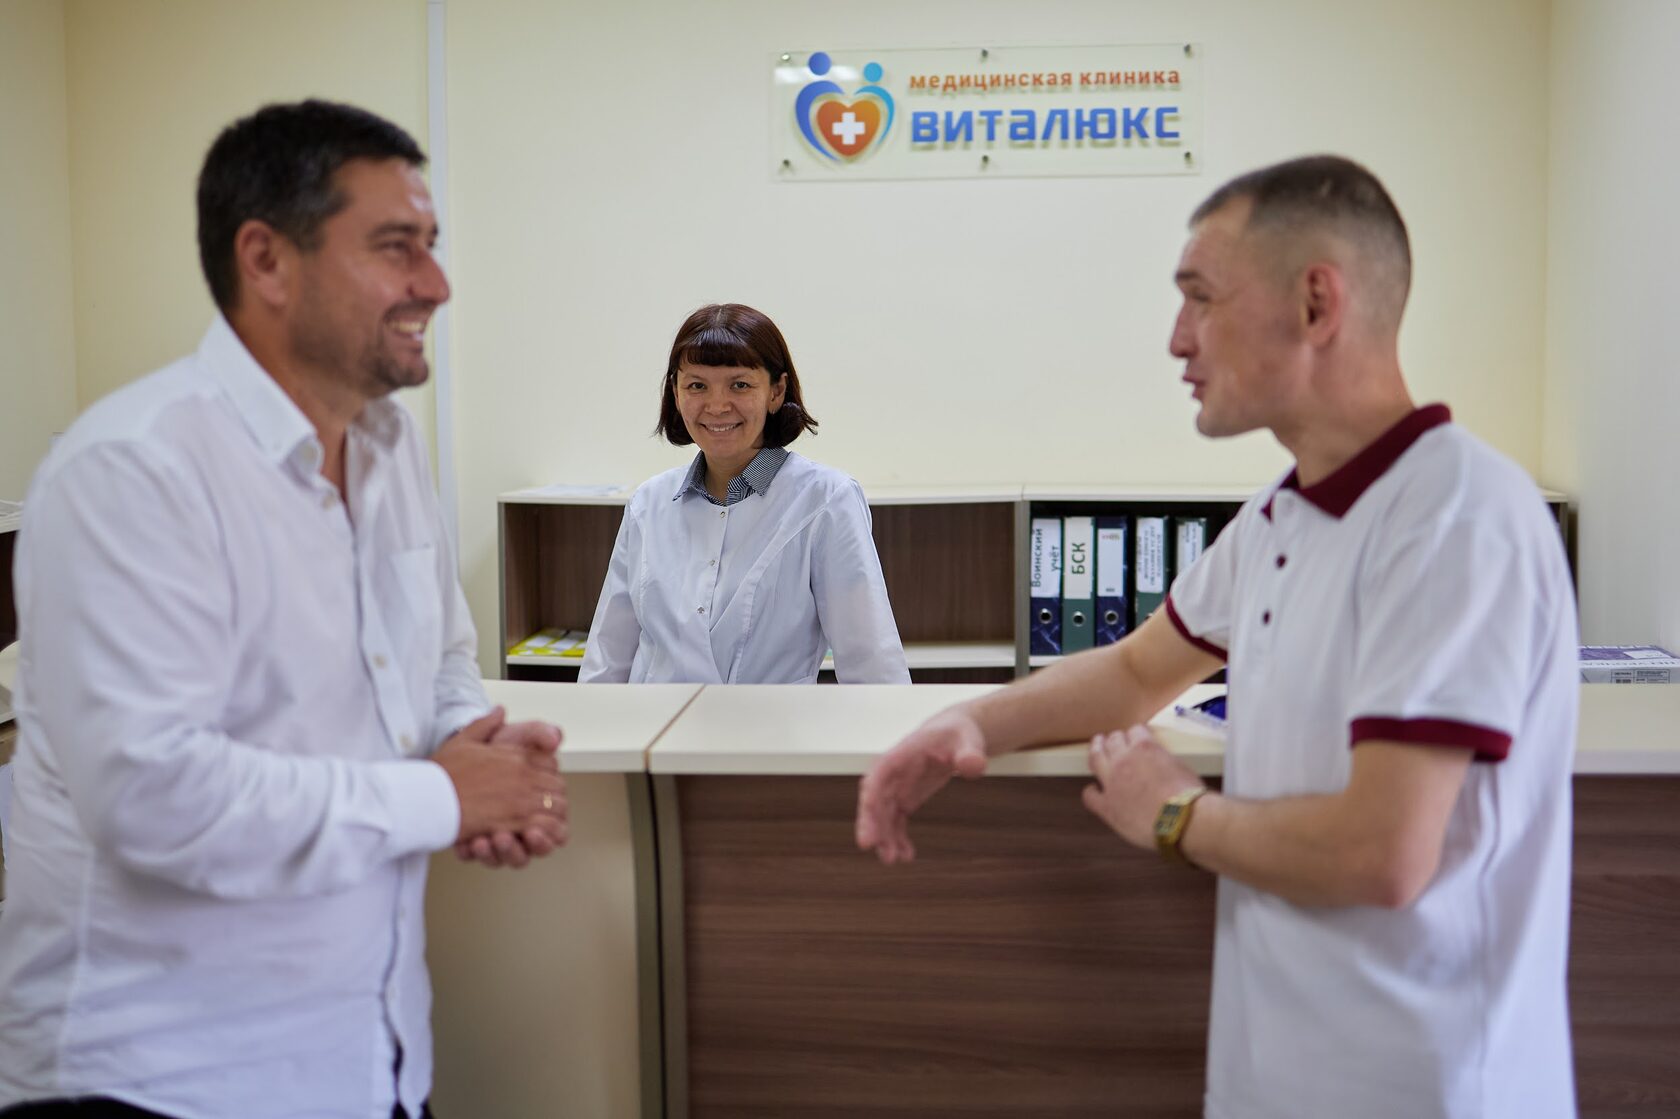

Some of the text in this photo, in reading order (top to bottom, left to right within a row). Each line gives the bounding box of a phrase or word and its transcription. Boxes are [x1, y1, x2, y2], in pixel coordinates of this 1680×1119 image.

[909, 69, 1181, 92] медицинская клиника
[1031, 528, 1043, 588] Воинский
[1071, 542, 1086, 575] БСК
